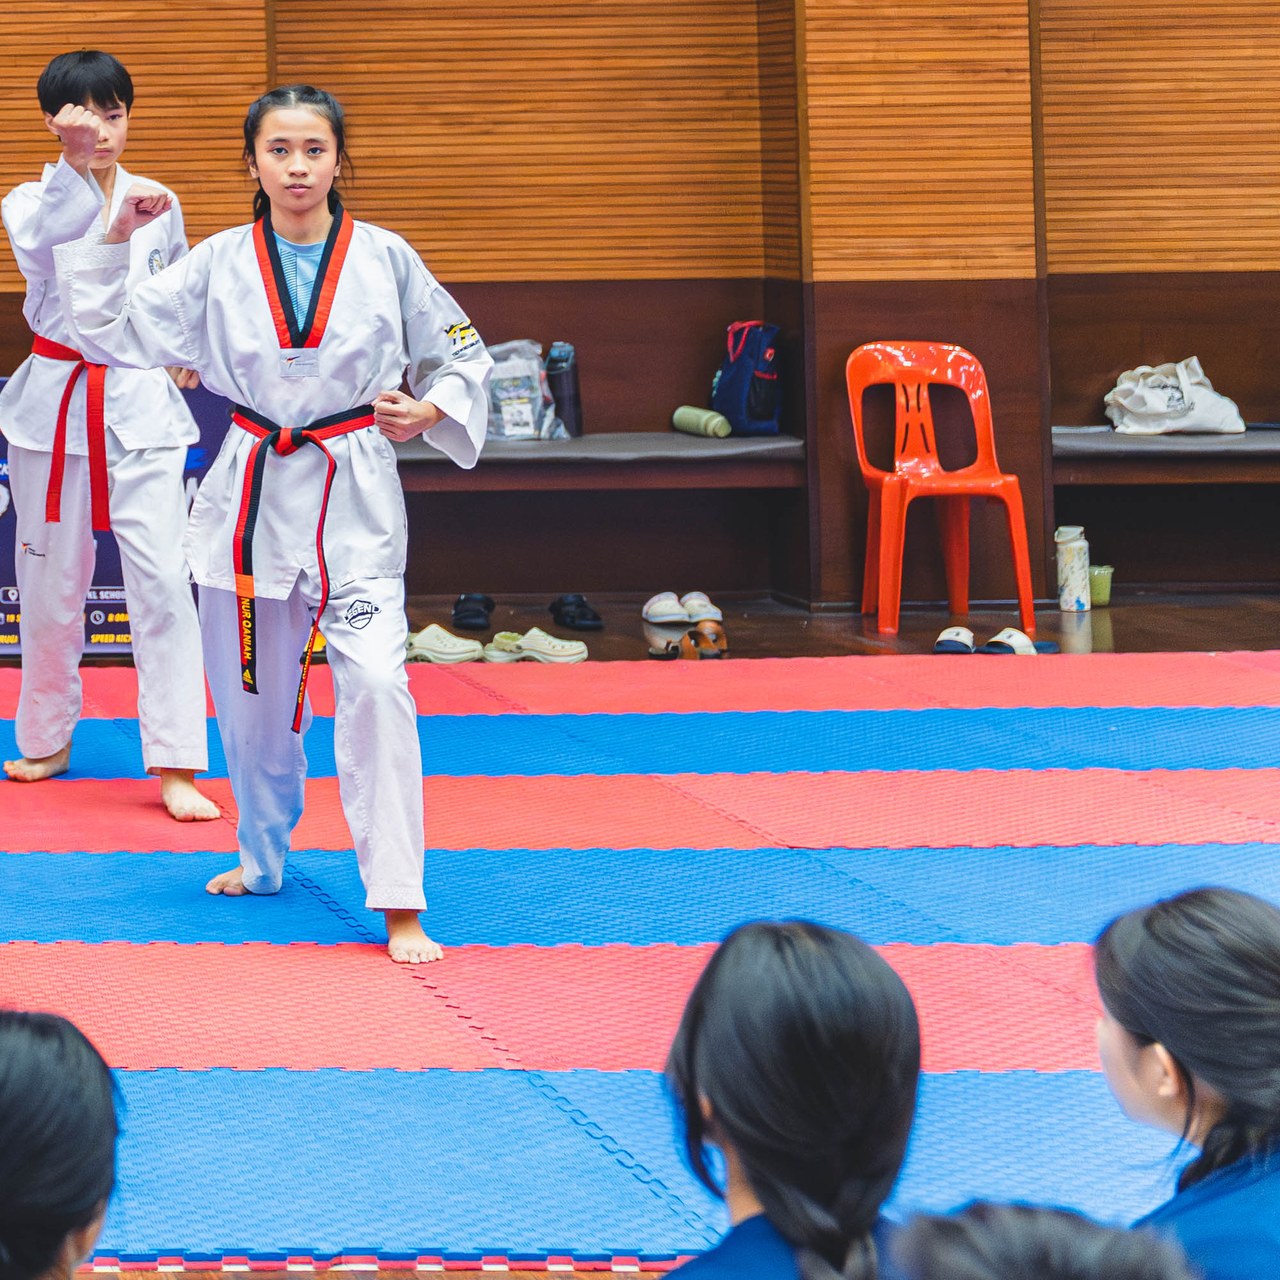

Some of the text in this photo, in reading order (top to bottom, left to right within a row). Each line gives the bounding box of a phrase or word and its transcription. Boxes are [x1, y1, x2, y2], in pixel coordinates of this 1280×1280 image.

[99, 590, 126, 600] SCHOO
[241, 597, 252, 620] NUR
[90, 634, 115, 643] SPEED
